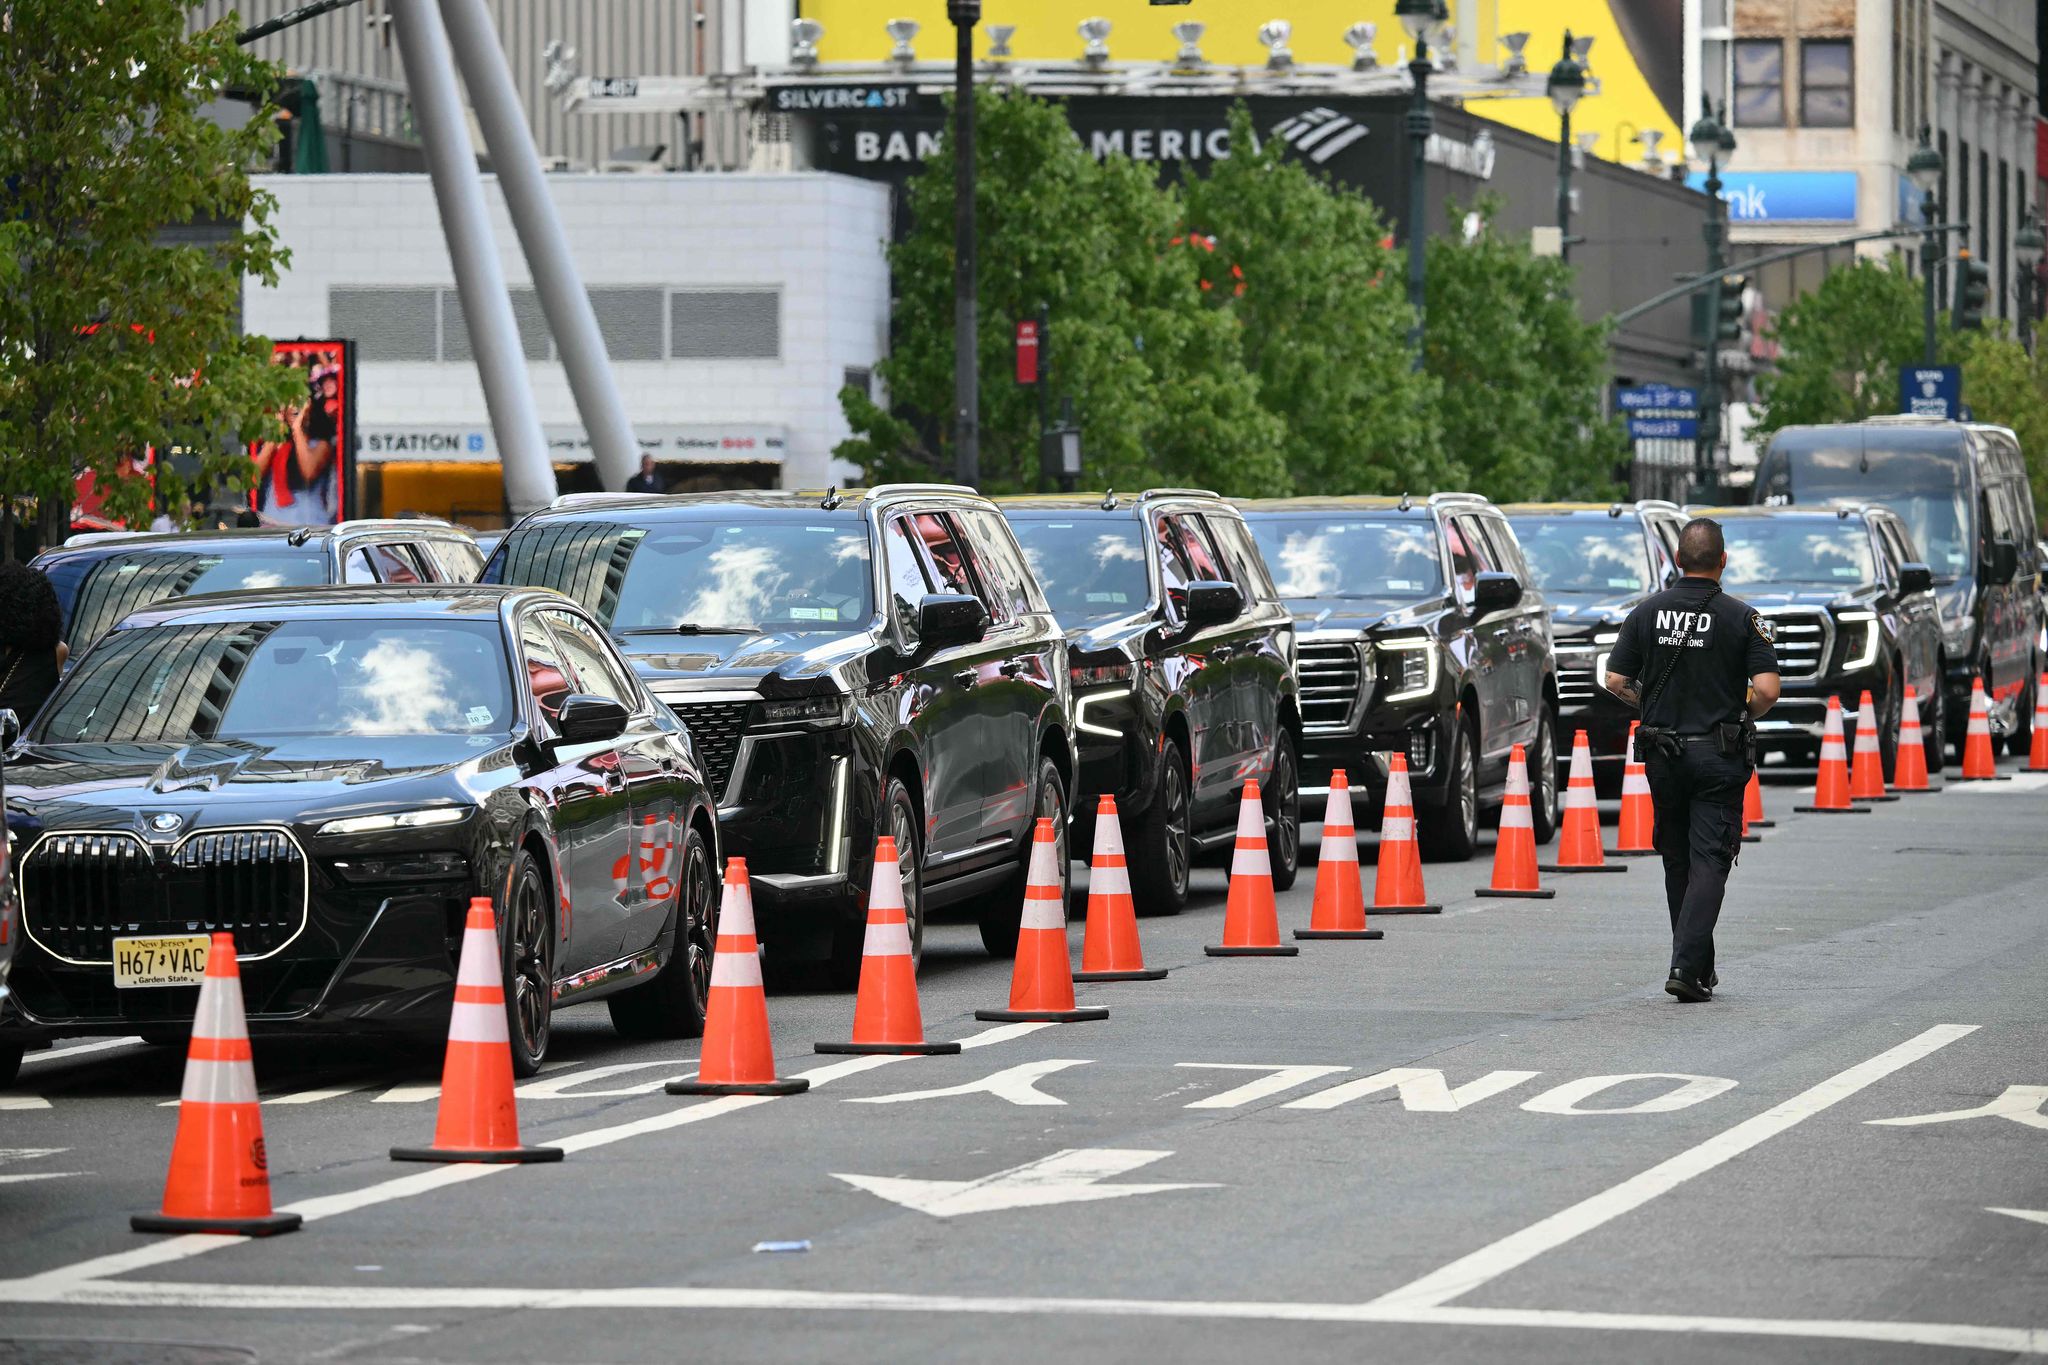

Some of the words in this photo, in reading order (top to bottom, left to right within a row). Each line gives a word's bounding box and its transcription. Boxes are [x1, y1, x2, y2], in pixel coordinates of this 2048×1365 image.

[854, 130, 944, 162] BAN
[1071, 128, 1262, 161] MERIC
[369, 434, 460, 450] STATION
[1656, 610, 1711, 632] NYPD
[1658, 636, 1704, 647] OPERAIONS
[137, 940, 158, 949] New
[160, 939, 187, 950] Jersey
[168, 975, 188, 983] State
